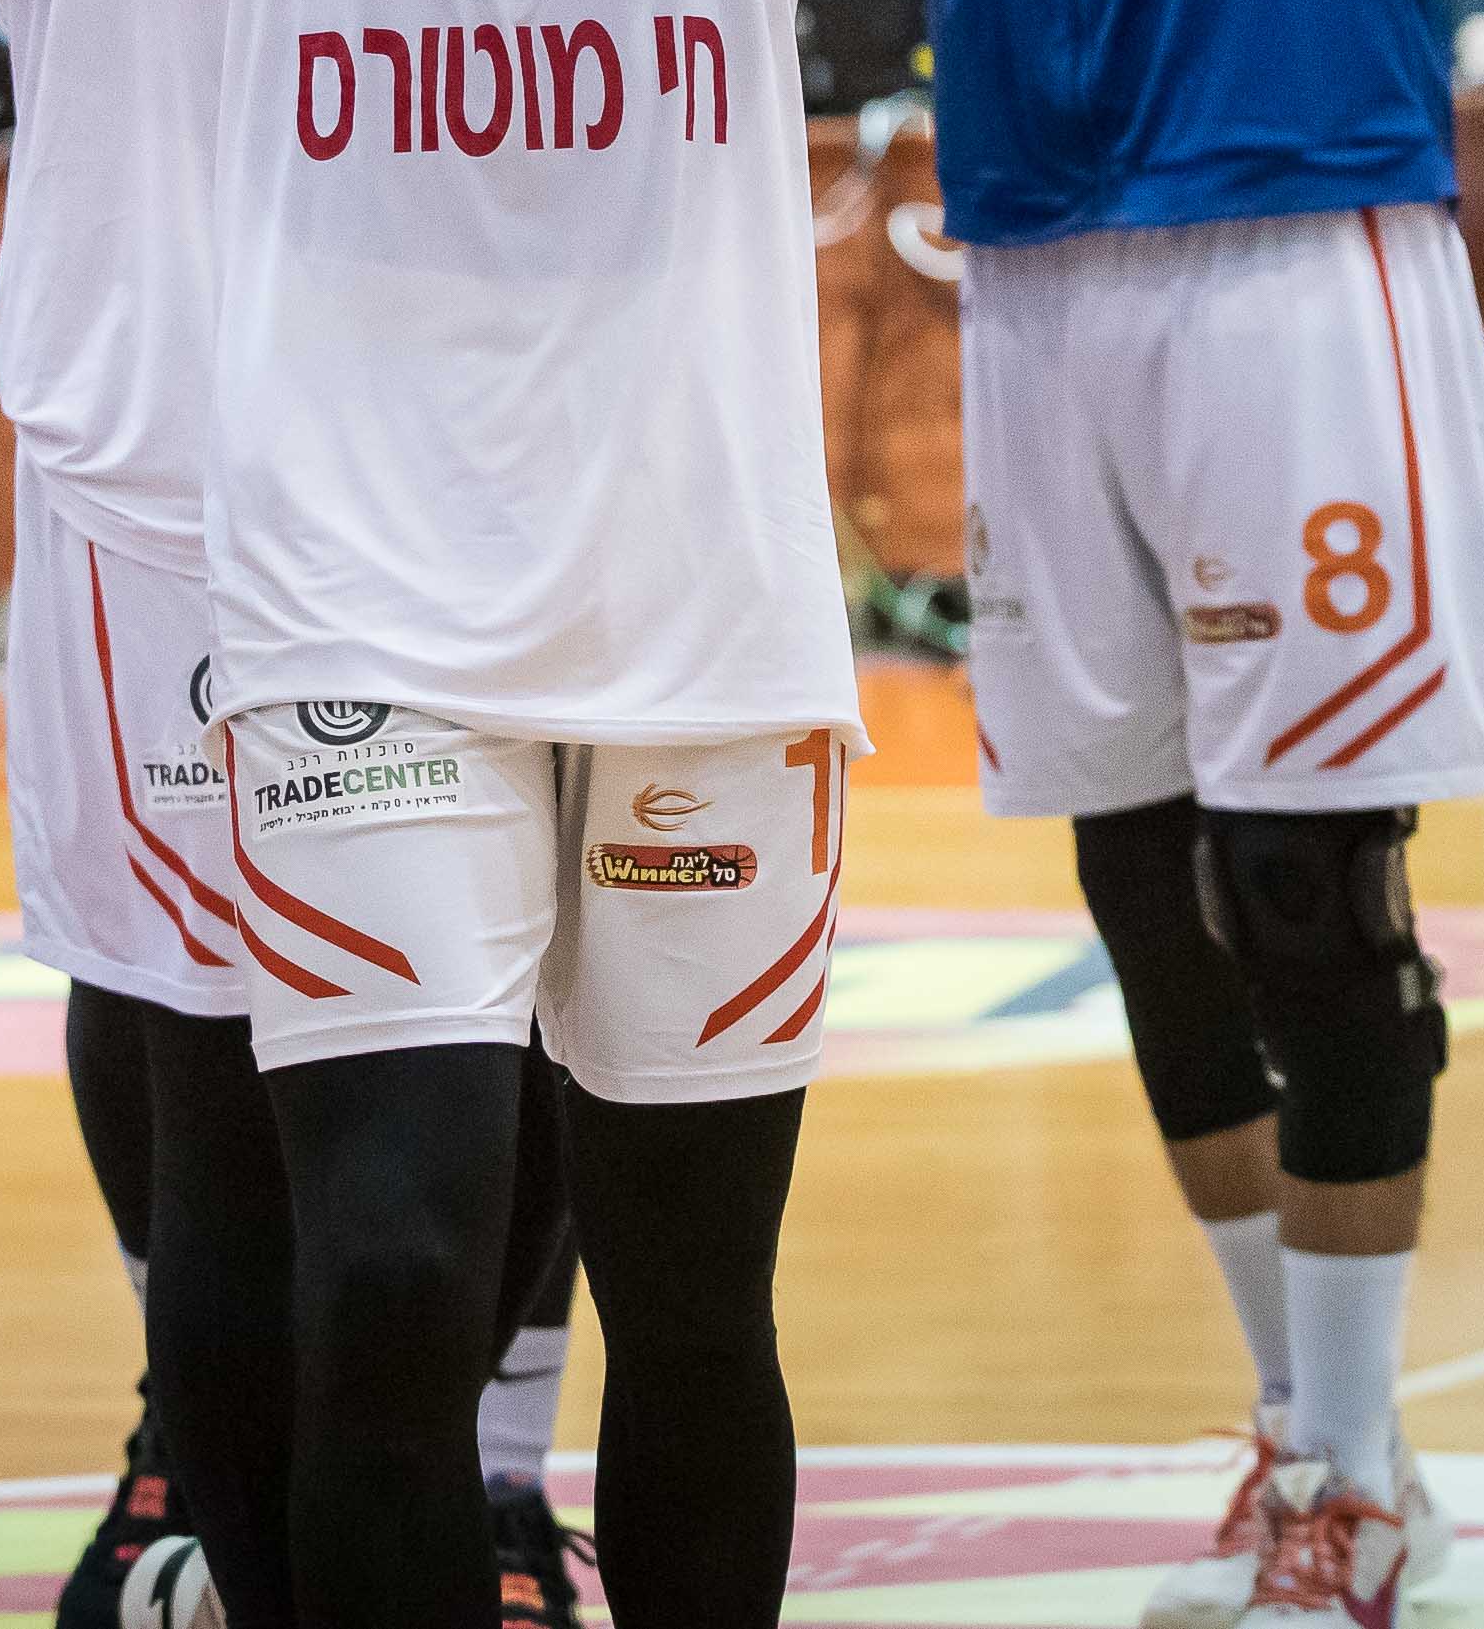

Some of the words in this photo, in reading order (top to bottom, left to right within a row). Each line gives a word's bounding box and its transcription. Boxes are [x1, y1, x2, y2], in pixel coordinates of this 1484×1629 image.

[296, 19, 625, 161] מוטורס
[654, 15, 727, 145] חי
[1302, 501, 1391, 635] 8
[338, 742, 415, 762] סוכנות
[254, 758, 461, 815] TRADECENTER
[785, 728, 833, 876] 1
[332, 805, 355, 817] יבוא
[603, 855, 710, 883] Winner
[672, 851, 710, 868] ליגת
[713, 863, 736, 882] סל
